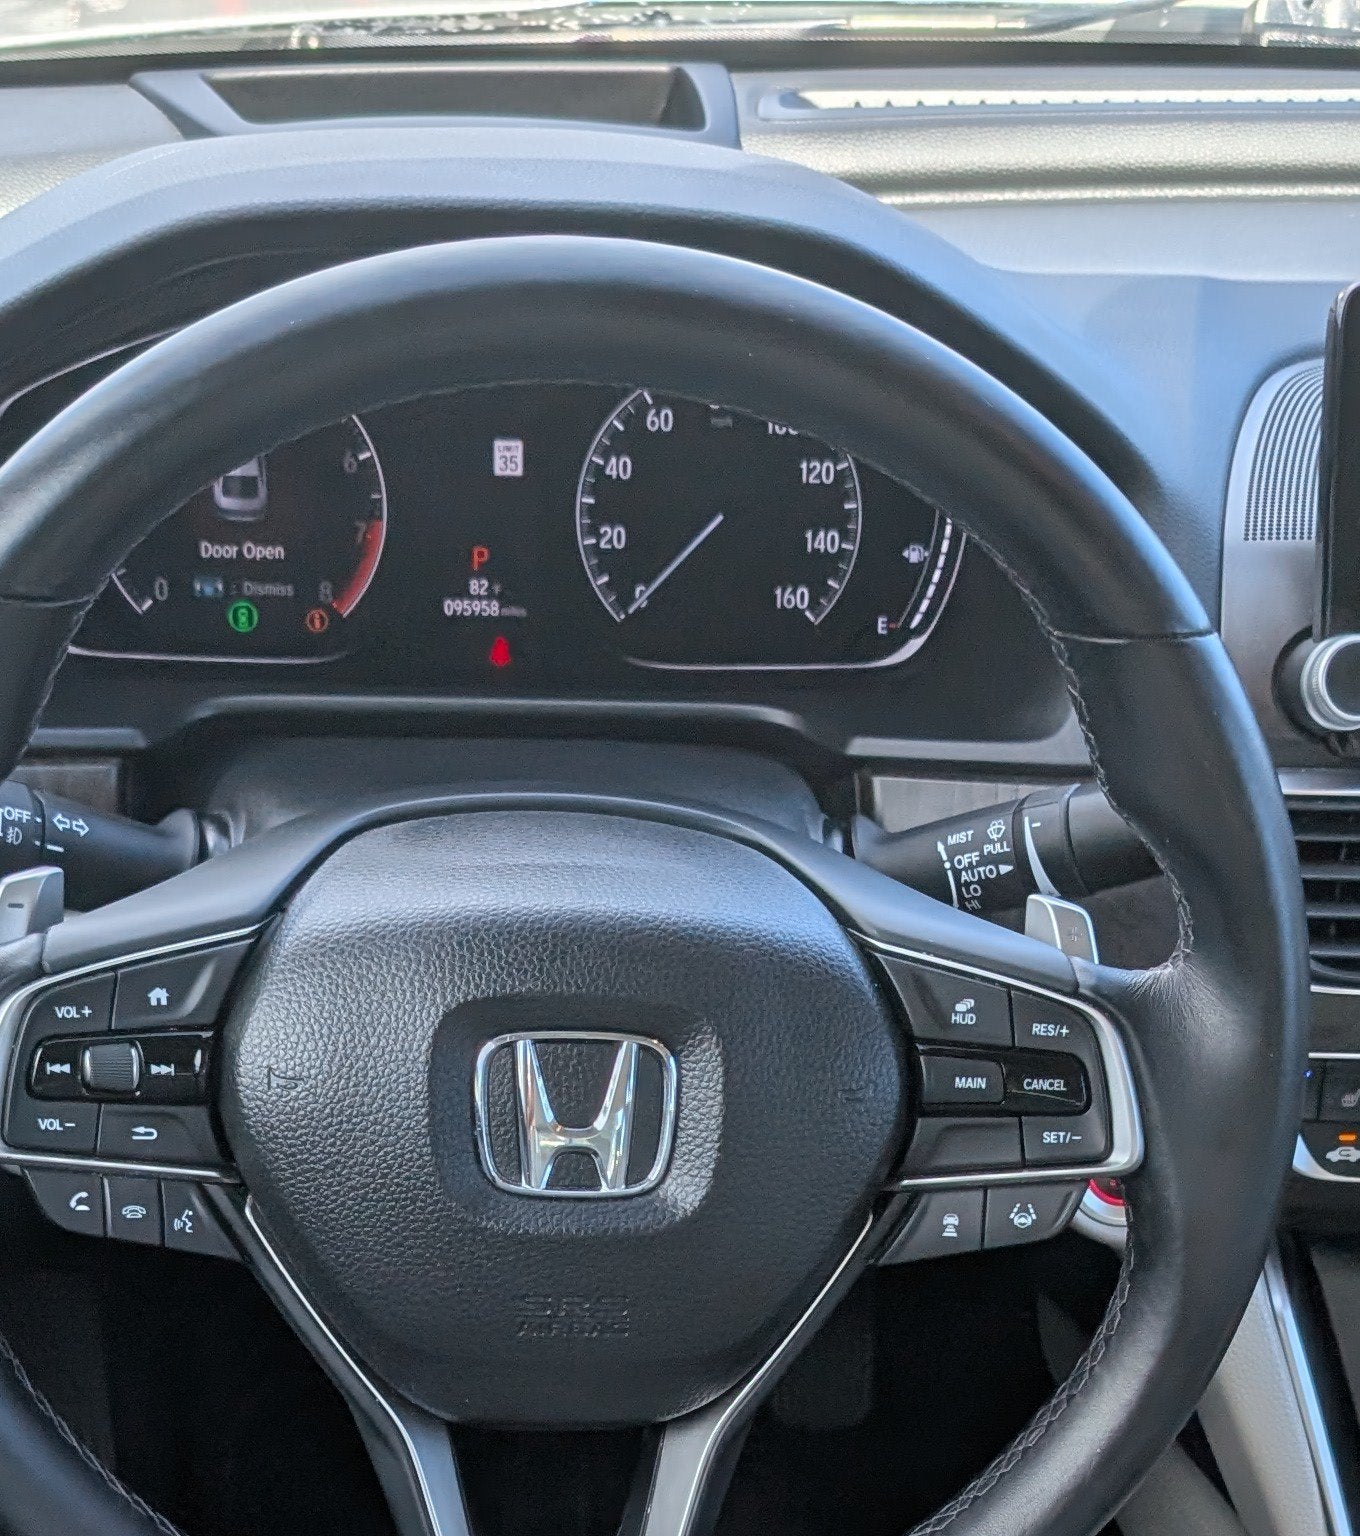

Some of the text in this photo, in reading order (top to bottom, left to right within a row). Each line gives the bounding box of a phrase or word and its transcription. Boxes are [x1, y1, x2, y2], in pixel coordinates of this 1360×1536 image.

[646, 408, 674, 432] 60
[343, 451, 358, 474] 6
[499, 454, 519, 472] 35
[605, 456, 632, 480] 40
[799, 460, 835, 484] 120
[355, 520, 367, 544] 7
[599, 526, 626, 550] 20
[804, 529, 840, 554] 140
[199, 541, 285, 562] Door Open
[471, 545, 490, 571] P
[154, 576, 169, 601] 0
[774, 586, 810, 610] 160
[443, 599, 500, 617] 095958
[877, 616, 888, 635] E
[3, 805, 32, 824] OFF
[947, 829, 974, 846] MIST
[983, 840, 1011, 856] PULL
[953, 851, 980, 870] OFF
[960, 864, 997, 884] AUTO
[961, 884, 982, 899] LO
[964, 899, 982, 911] HI
[951, 1012, 977, 1025] HUD
[1031, 1022, 1070, 1037] RES/+
[954, 1076, 987, 1090] MAIN
[1023, 1078, 1068, 1091] CANCEL
